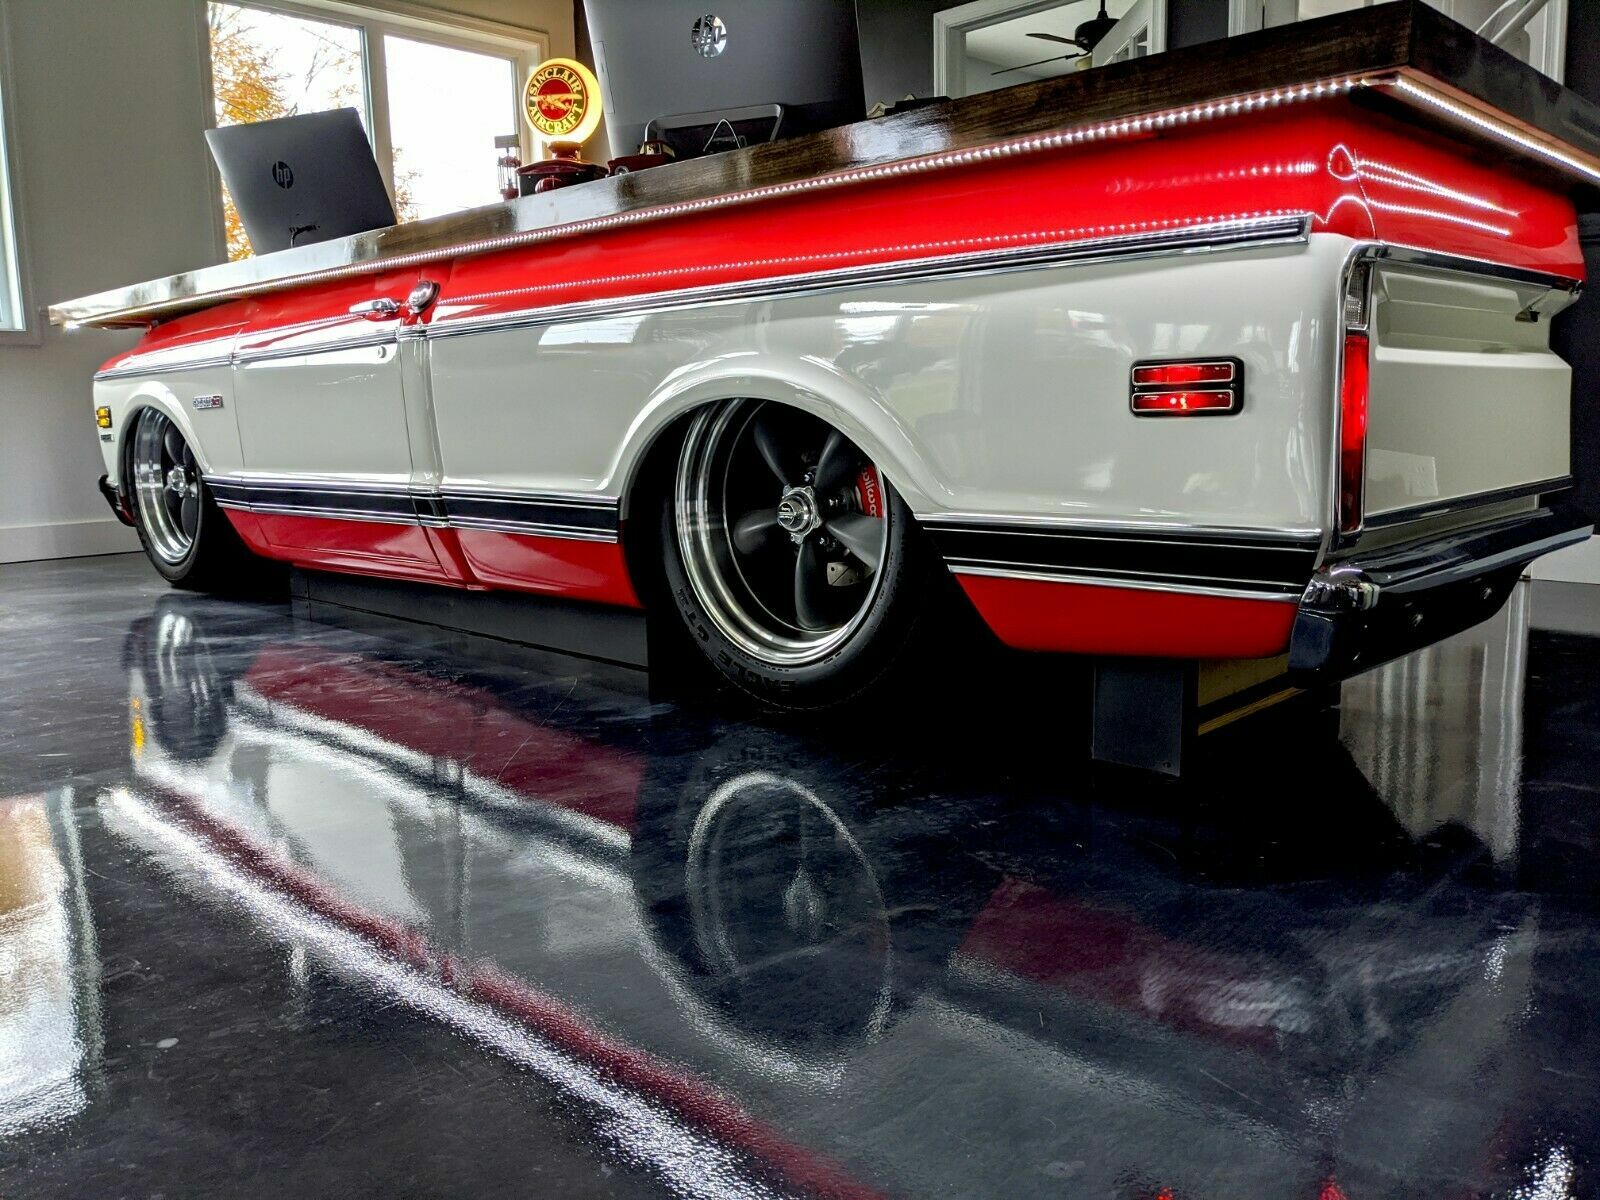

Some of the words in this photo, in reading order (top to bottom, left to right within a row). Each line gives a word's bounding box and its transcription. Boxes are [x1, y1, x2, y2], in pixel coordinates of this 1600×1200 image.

[529, 67, 582, 96] SINCLAIR
[529, 103, 583, 133] AIRCRAFT
[272, 161, 294, 189] hp
